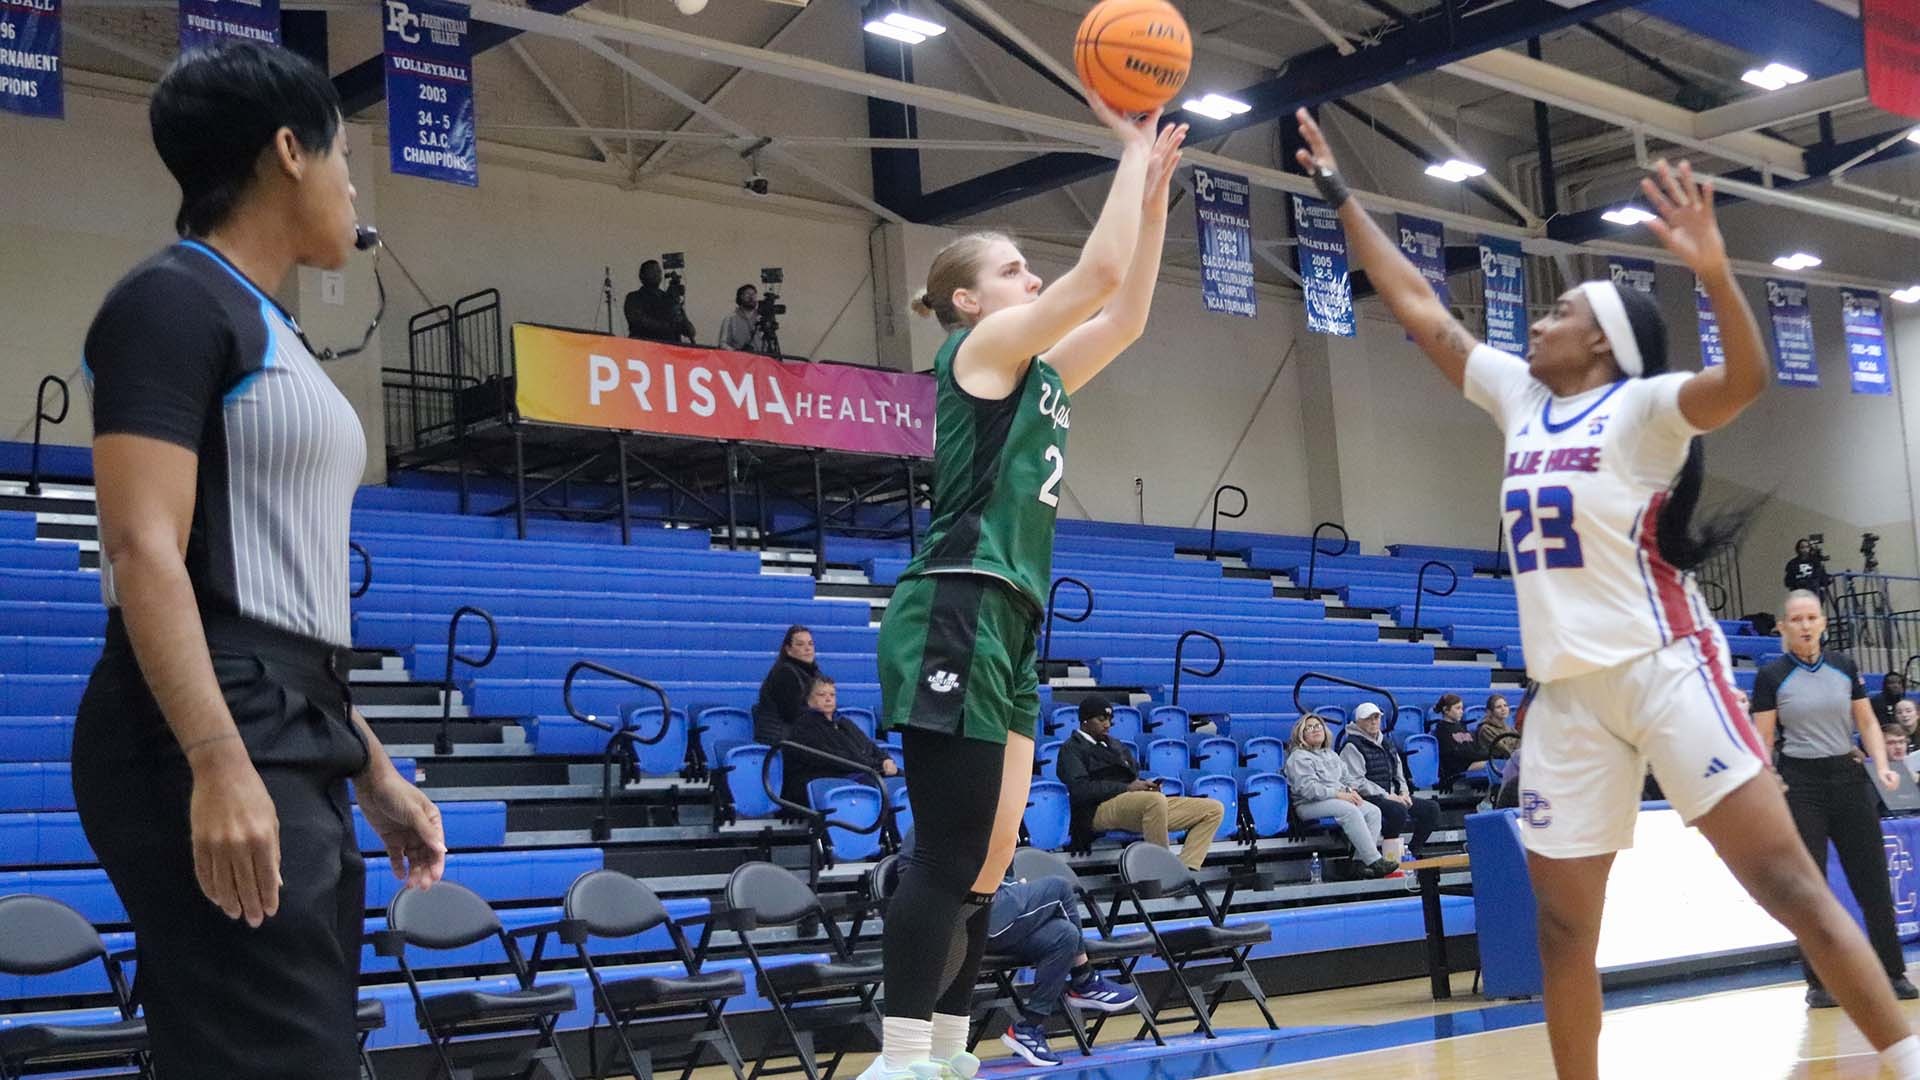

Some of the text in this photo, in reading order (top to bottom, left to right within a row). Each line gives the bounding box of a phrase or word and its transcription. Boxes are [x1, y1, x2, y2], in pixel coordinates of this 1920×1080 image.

[223, 22, 274, 43] VOLLEYBALL
[393, 56, 468, 81] VOLLEYBALL
[419, 84, 447, 103] 2003
[404, 147, 467, 171] CHAMPIONS
[1199, 209, 1250, 228] VOLLEYBALL
[1216, 229, 1237, 244] 2004
[1312, 254, 1332, 268] 2005
[588, 354, 794, 426] PRISMA
[1038, 445, 1064, 508] 2
[1505, 485, 1584, 575] 23
[1522, 789, 1552, 829] PC
